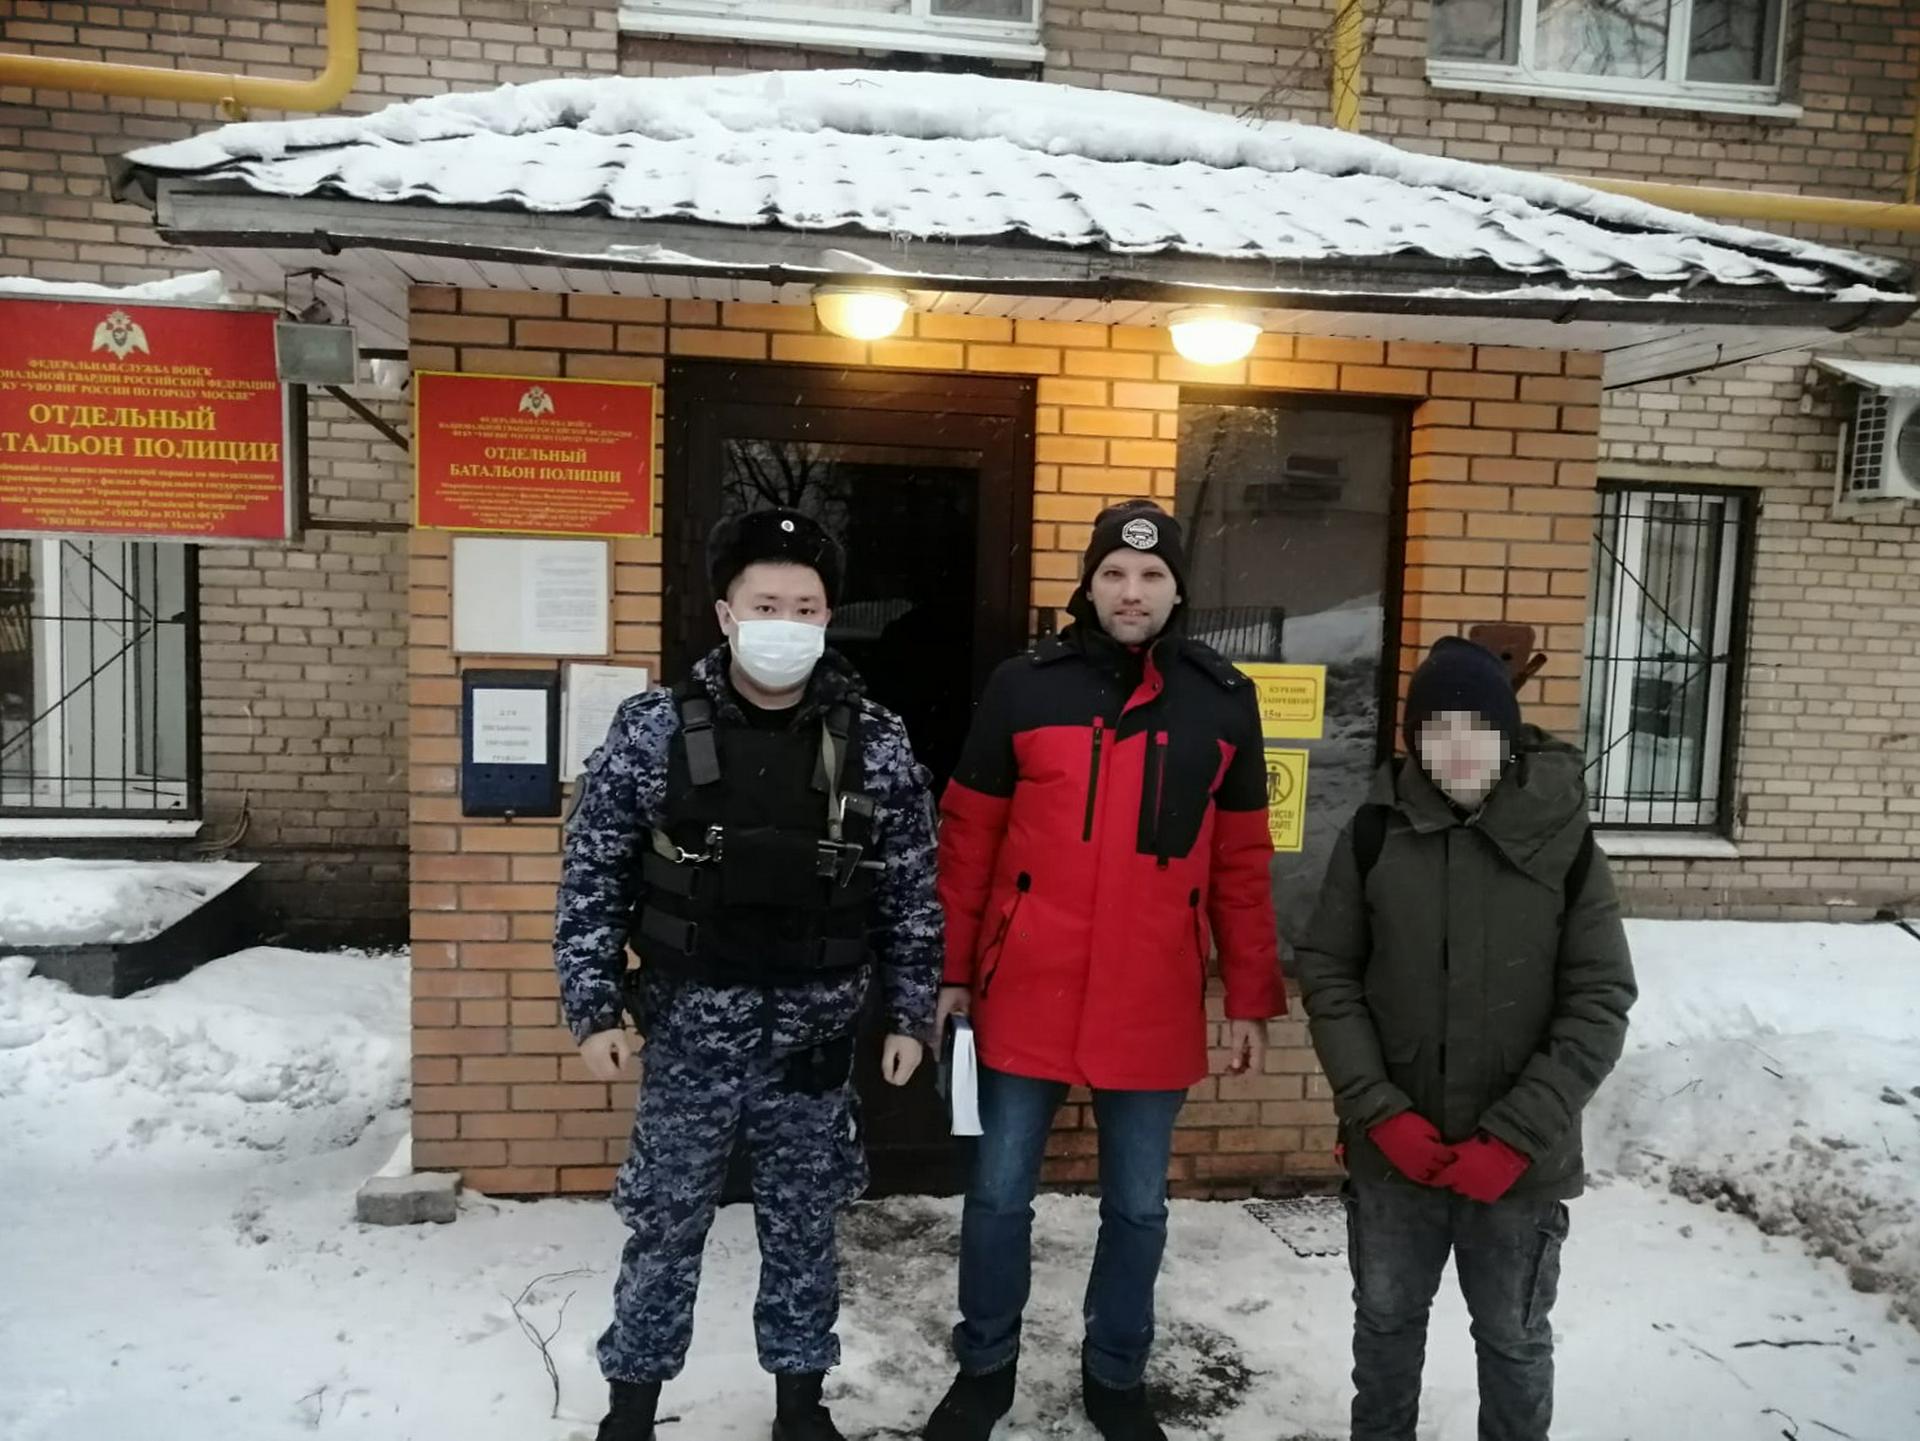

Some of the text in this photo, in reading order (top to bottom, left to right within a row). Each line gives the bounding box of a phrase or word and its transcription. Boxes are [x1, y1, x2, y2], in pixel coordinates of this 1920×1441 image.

[29, 403, 216, 430] ОТДЕЛЬНЫЙ
[0, 432, 280, 464] ТАЛЬОН ПОЛИЦИИ
[484, 447, 588, 464] ОТДЕЛЬНЫЙ
[450, 463, 622, 484] БАТАЛЬОН ПОЛИЦИИ
